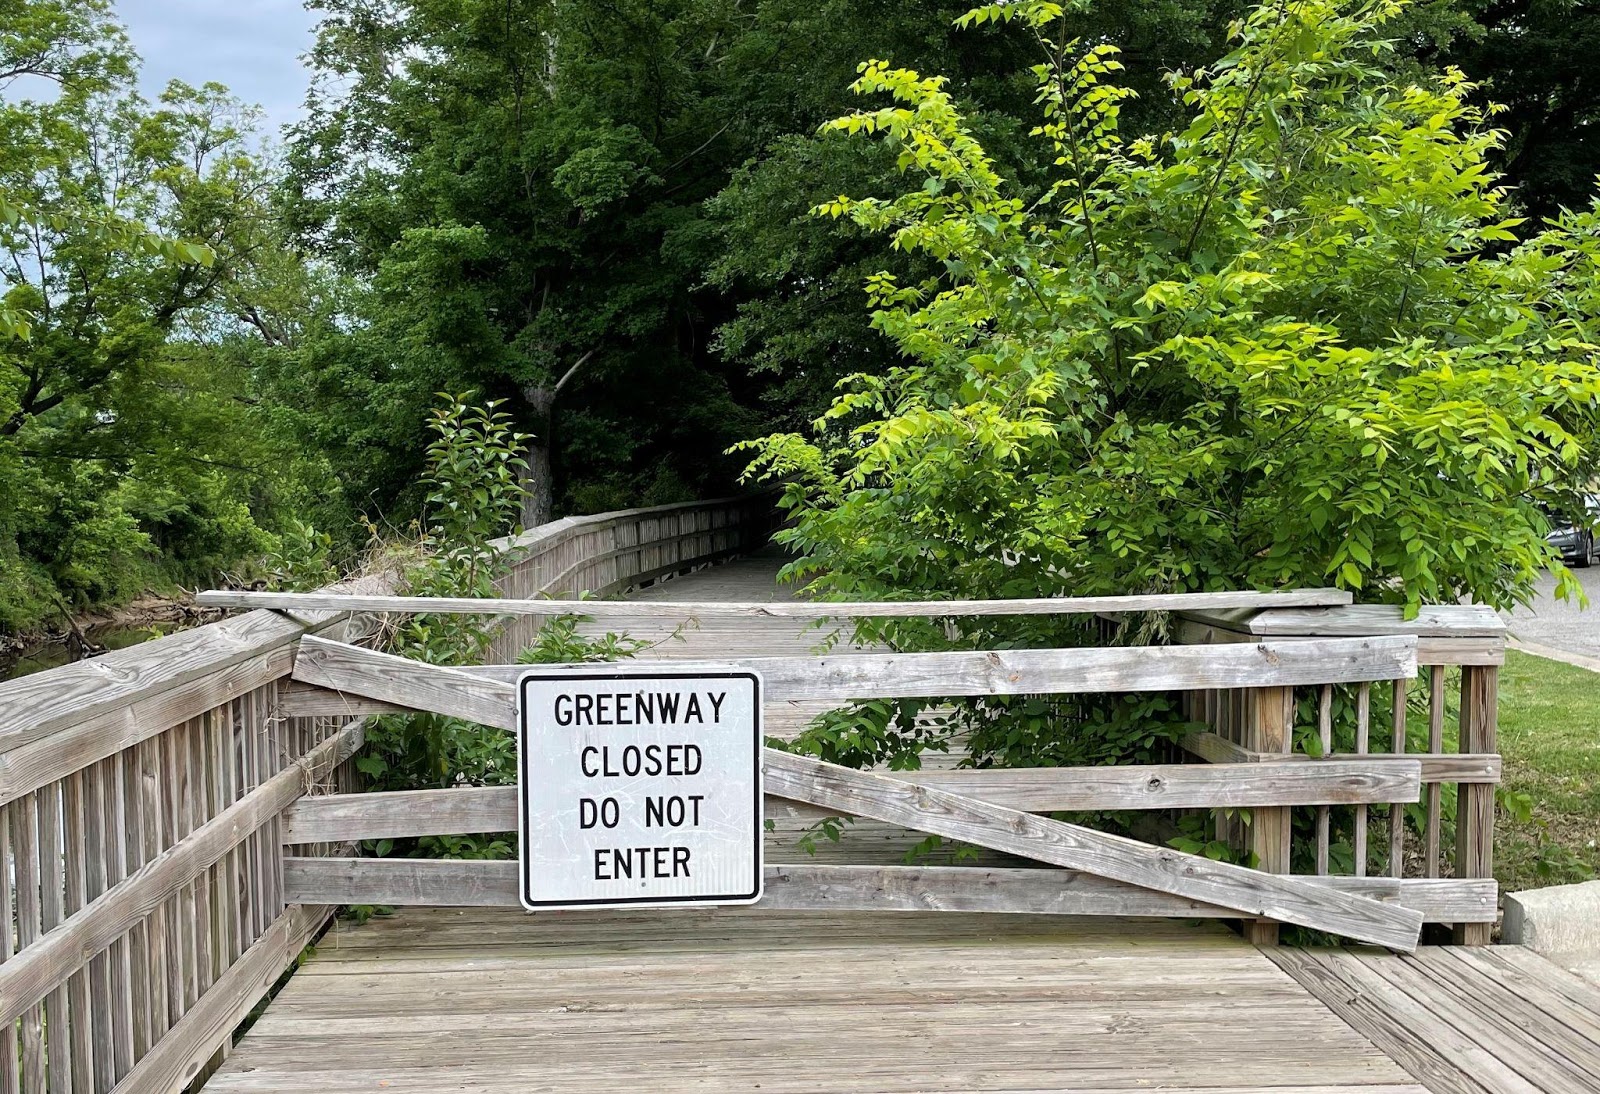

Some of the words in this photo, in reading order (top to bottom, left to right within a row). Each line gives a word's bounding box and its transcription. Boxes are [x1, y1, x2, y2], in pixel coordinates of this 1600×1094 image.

[554, 692, 727, 727] GREENWAY
[581, 744, 703, 777] CLOSED
[579, 797, 620, 829] DO
[645, 795, 704, 828] NOT
[594, 846, 691, 880] ENTER
